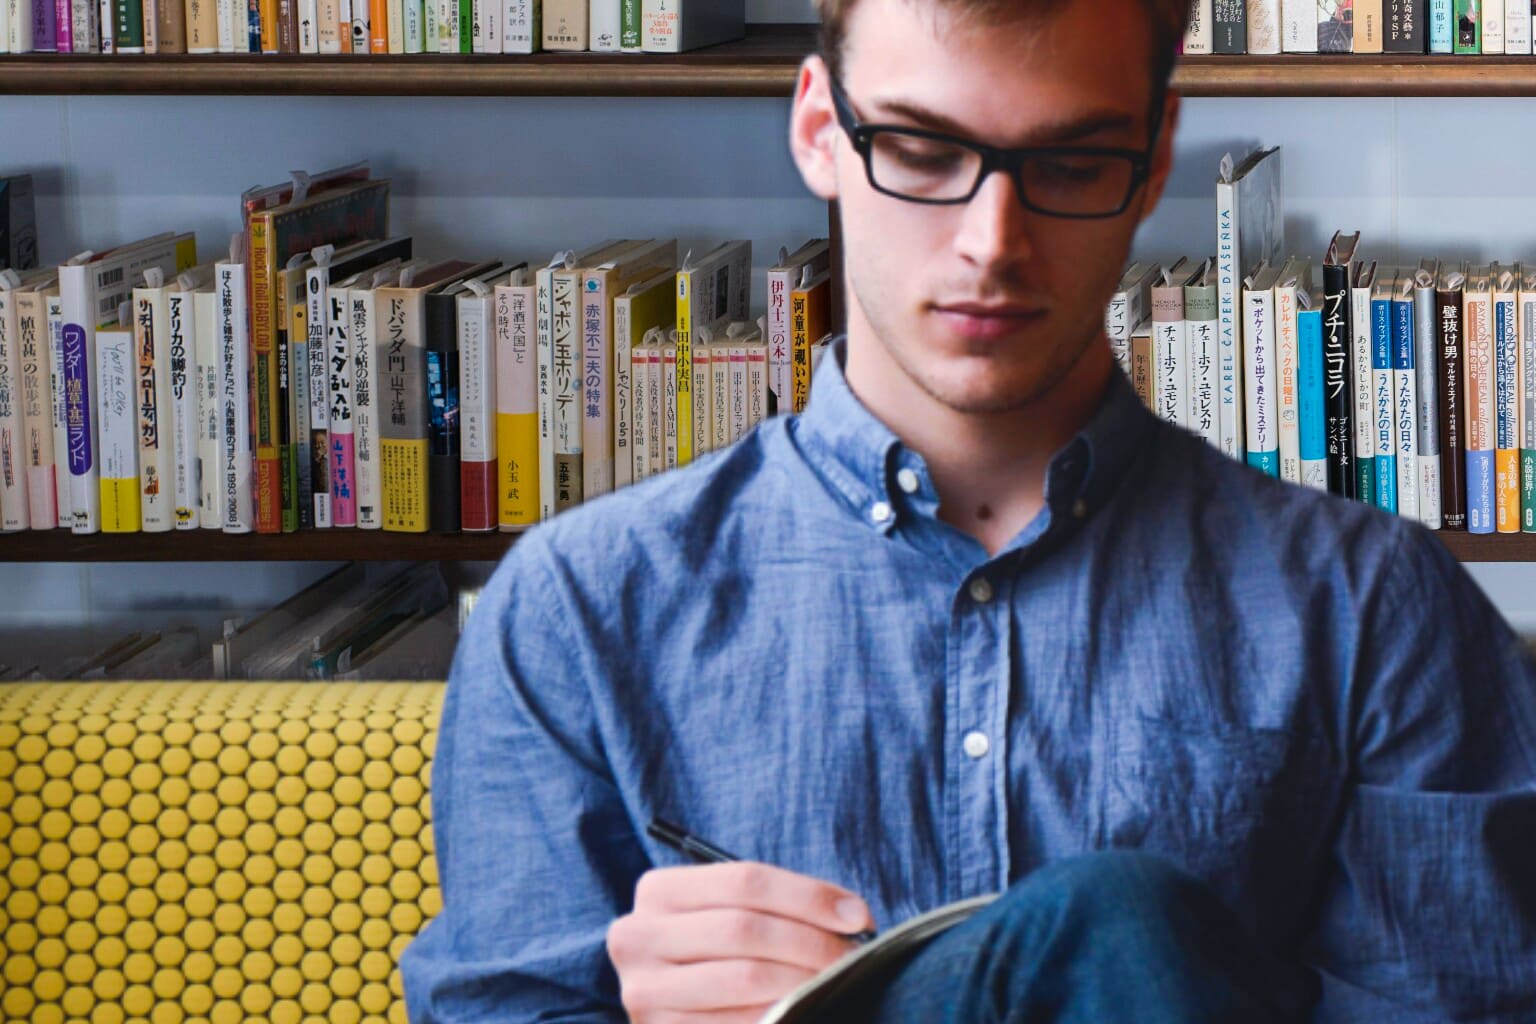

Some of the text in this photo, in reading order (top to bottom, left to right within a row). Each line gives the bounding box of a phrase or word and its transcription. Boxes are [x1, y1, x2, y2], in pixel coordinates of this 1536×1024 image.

[170, 297, 187, 400] アメリカの鱒釣り
[256, 302, 269, 347] BABYLON
[309, 324, 323, 377] 加藤和彦
[353, 299, 370, 407] 風雲ジャズ帖の逆襲
[388, 298, 405, 372] ドバラダ門
[554, 279, 573, 421] シャボン玉ホリデー
[585, 303, 600, 418] 赤塚不二夫の特集
[1281, 294, 1293, 406] カレル・チャペックの日曜日
[1325, 290, 1346, 399] プチ・ニコラ
[1442, 306, 1458, 359] 壁抜け男
[1224, 354, 1233, 404] KAREL
[1254, 307, 1267, 453] ポケットから出てきたミステリー
[1378, 374, 1390, 453] うたかたの日々
[1400, 374, 1412, 453] うたかたの日々
